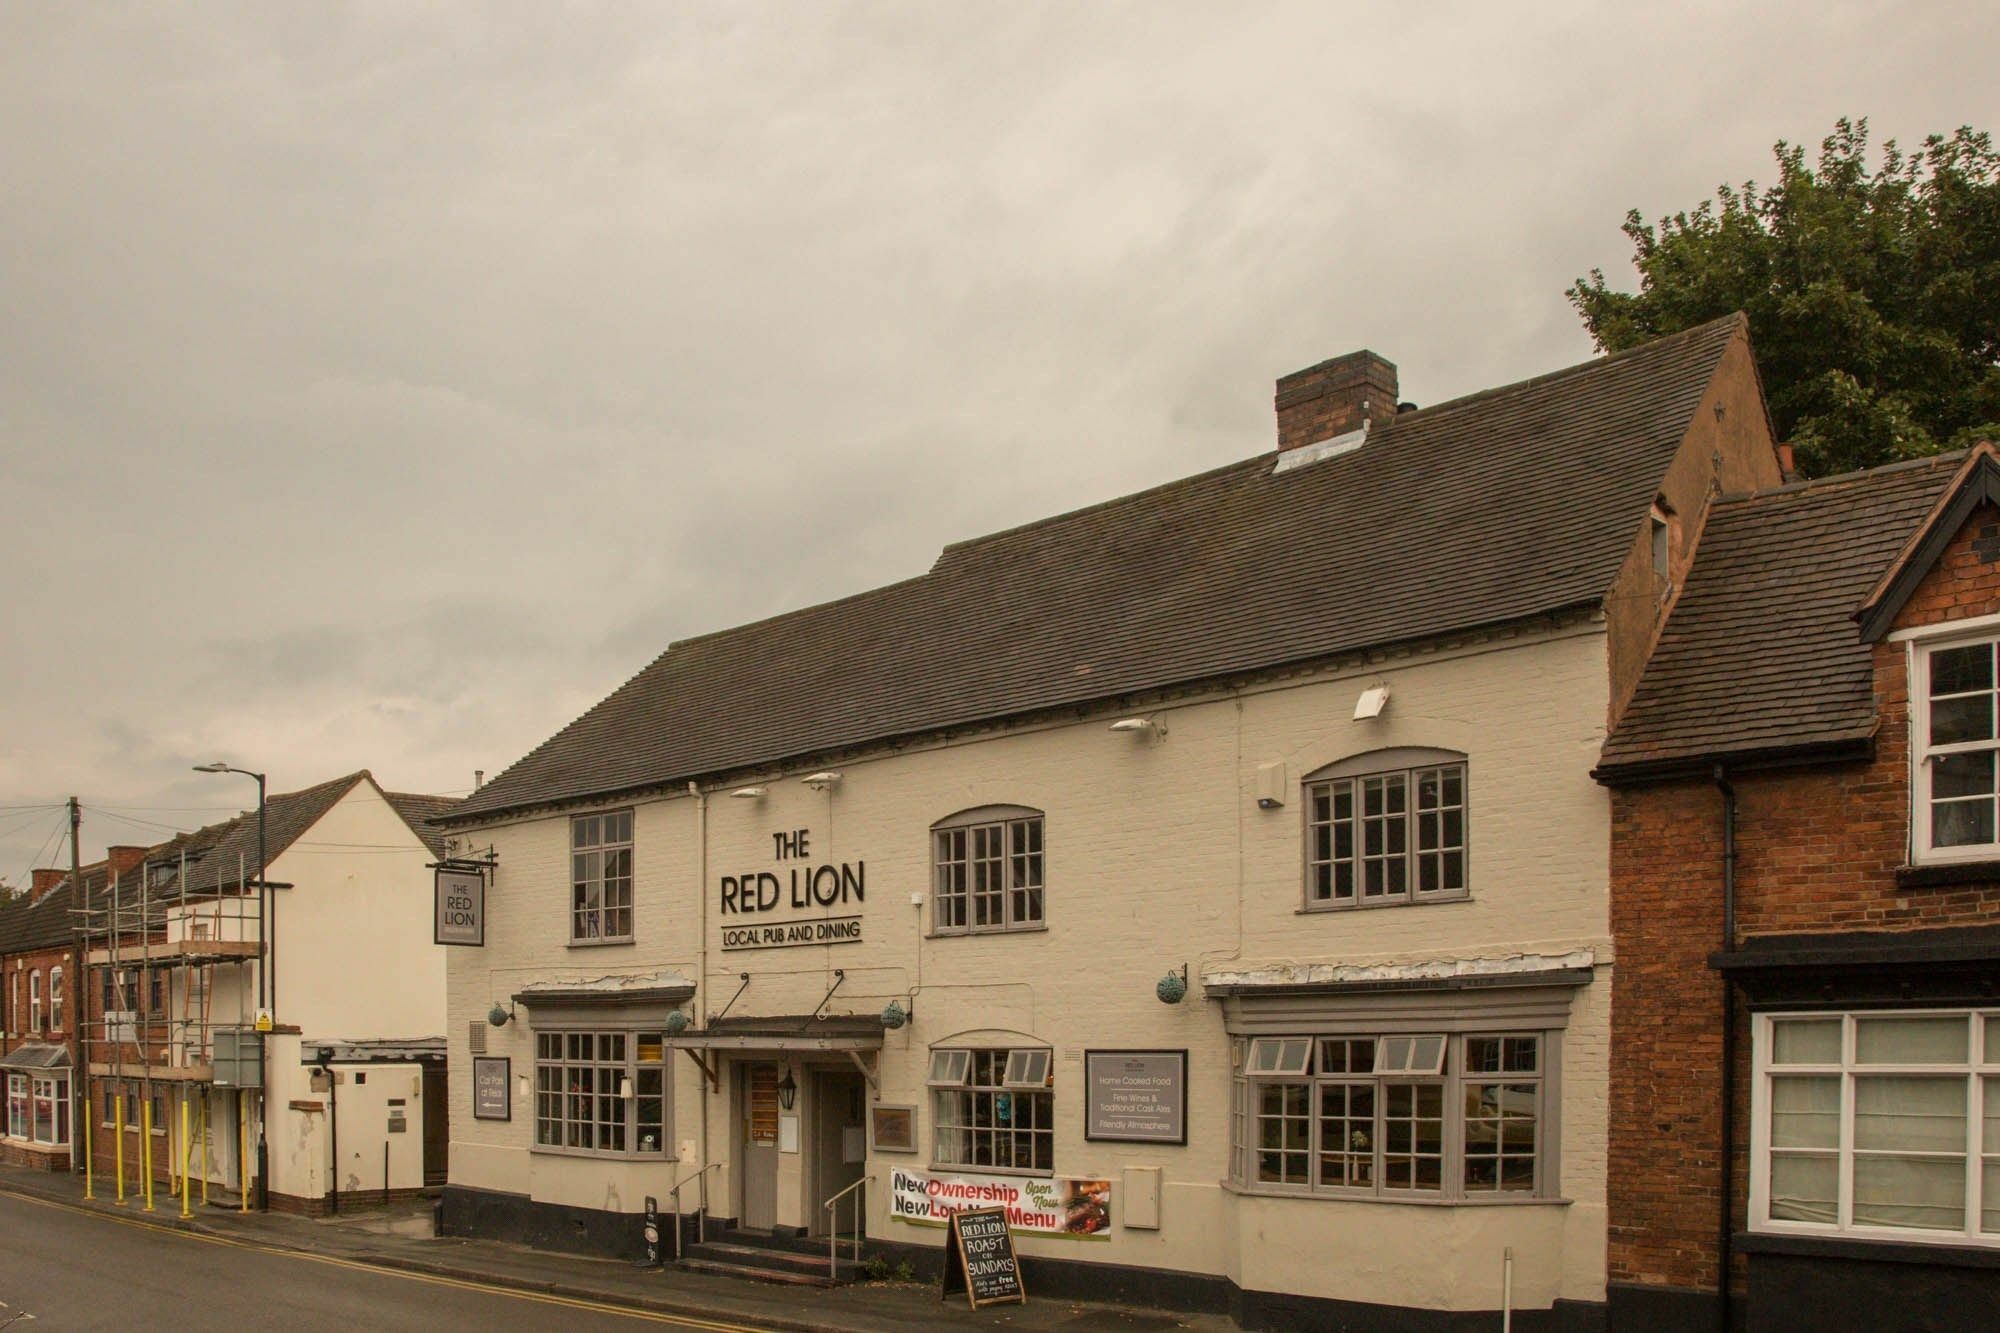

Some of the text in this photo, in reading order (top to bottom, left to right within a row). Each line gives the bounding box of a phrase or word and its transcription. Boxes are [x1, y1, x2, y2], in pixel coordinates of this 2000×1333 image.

[773, 829, 810, 861] THE
[453, 884, 469, 895] THE
[721, 860, 864, 914] RED LION
[447, 896, 473, 910] RED
[445, 912, 475, 926] LION
[723, 921, 861, 946] LOCAL PUB AND DINING
[1099, 1076, 1172, 1086] Home Cooked Food
[1113, 1094, 1159, 1103] Fine Wines &
[1100, 1104, 1135, 1112] Traditional
[1136, 1104, 1154, 1112] Cask
[1099, 1120, 1170, 1131] Friendly Atmosphere
[895, 1173, 1019, 1206] New Ownership
[1025, 1180, 1053, 1196] Open
[895, 1195, 929, 1216] New
[1033, 1195, 1059, 1211] Now
[1007, 1206, 1056, 1228] Menu
[961, 1221, 1006, 1237] RED LION
[966, 1237, 1004, 1254] ROAST
[968, 1258, 1015, 1276] SUNDAYS
[999, 1276, 1014, 1285] free
